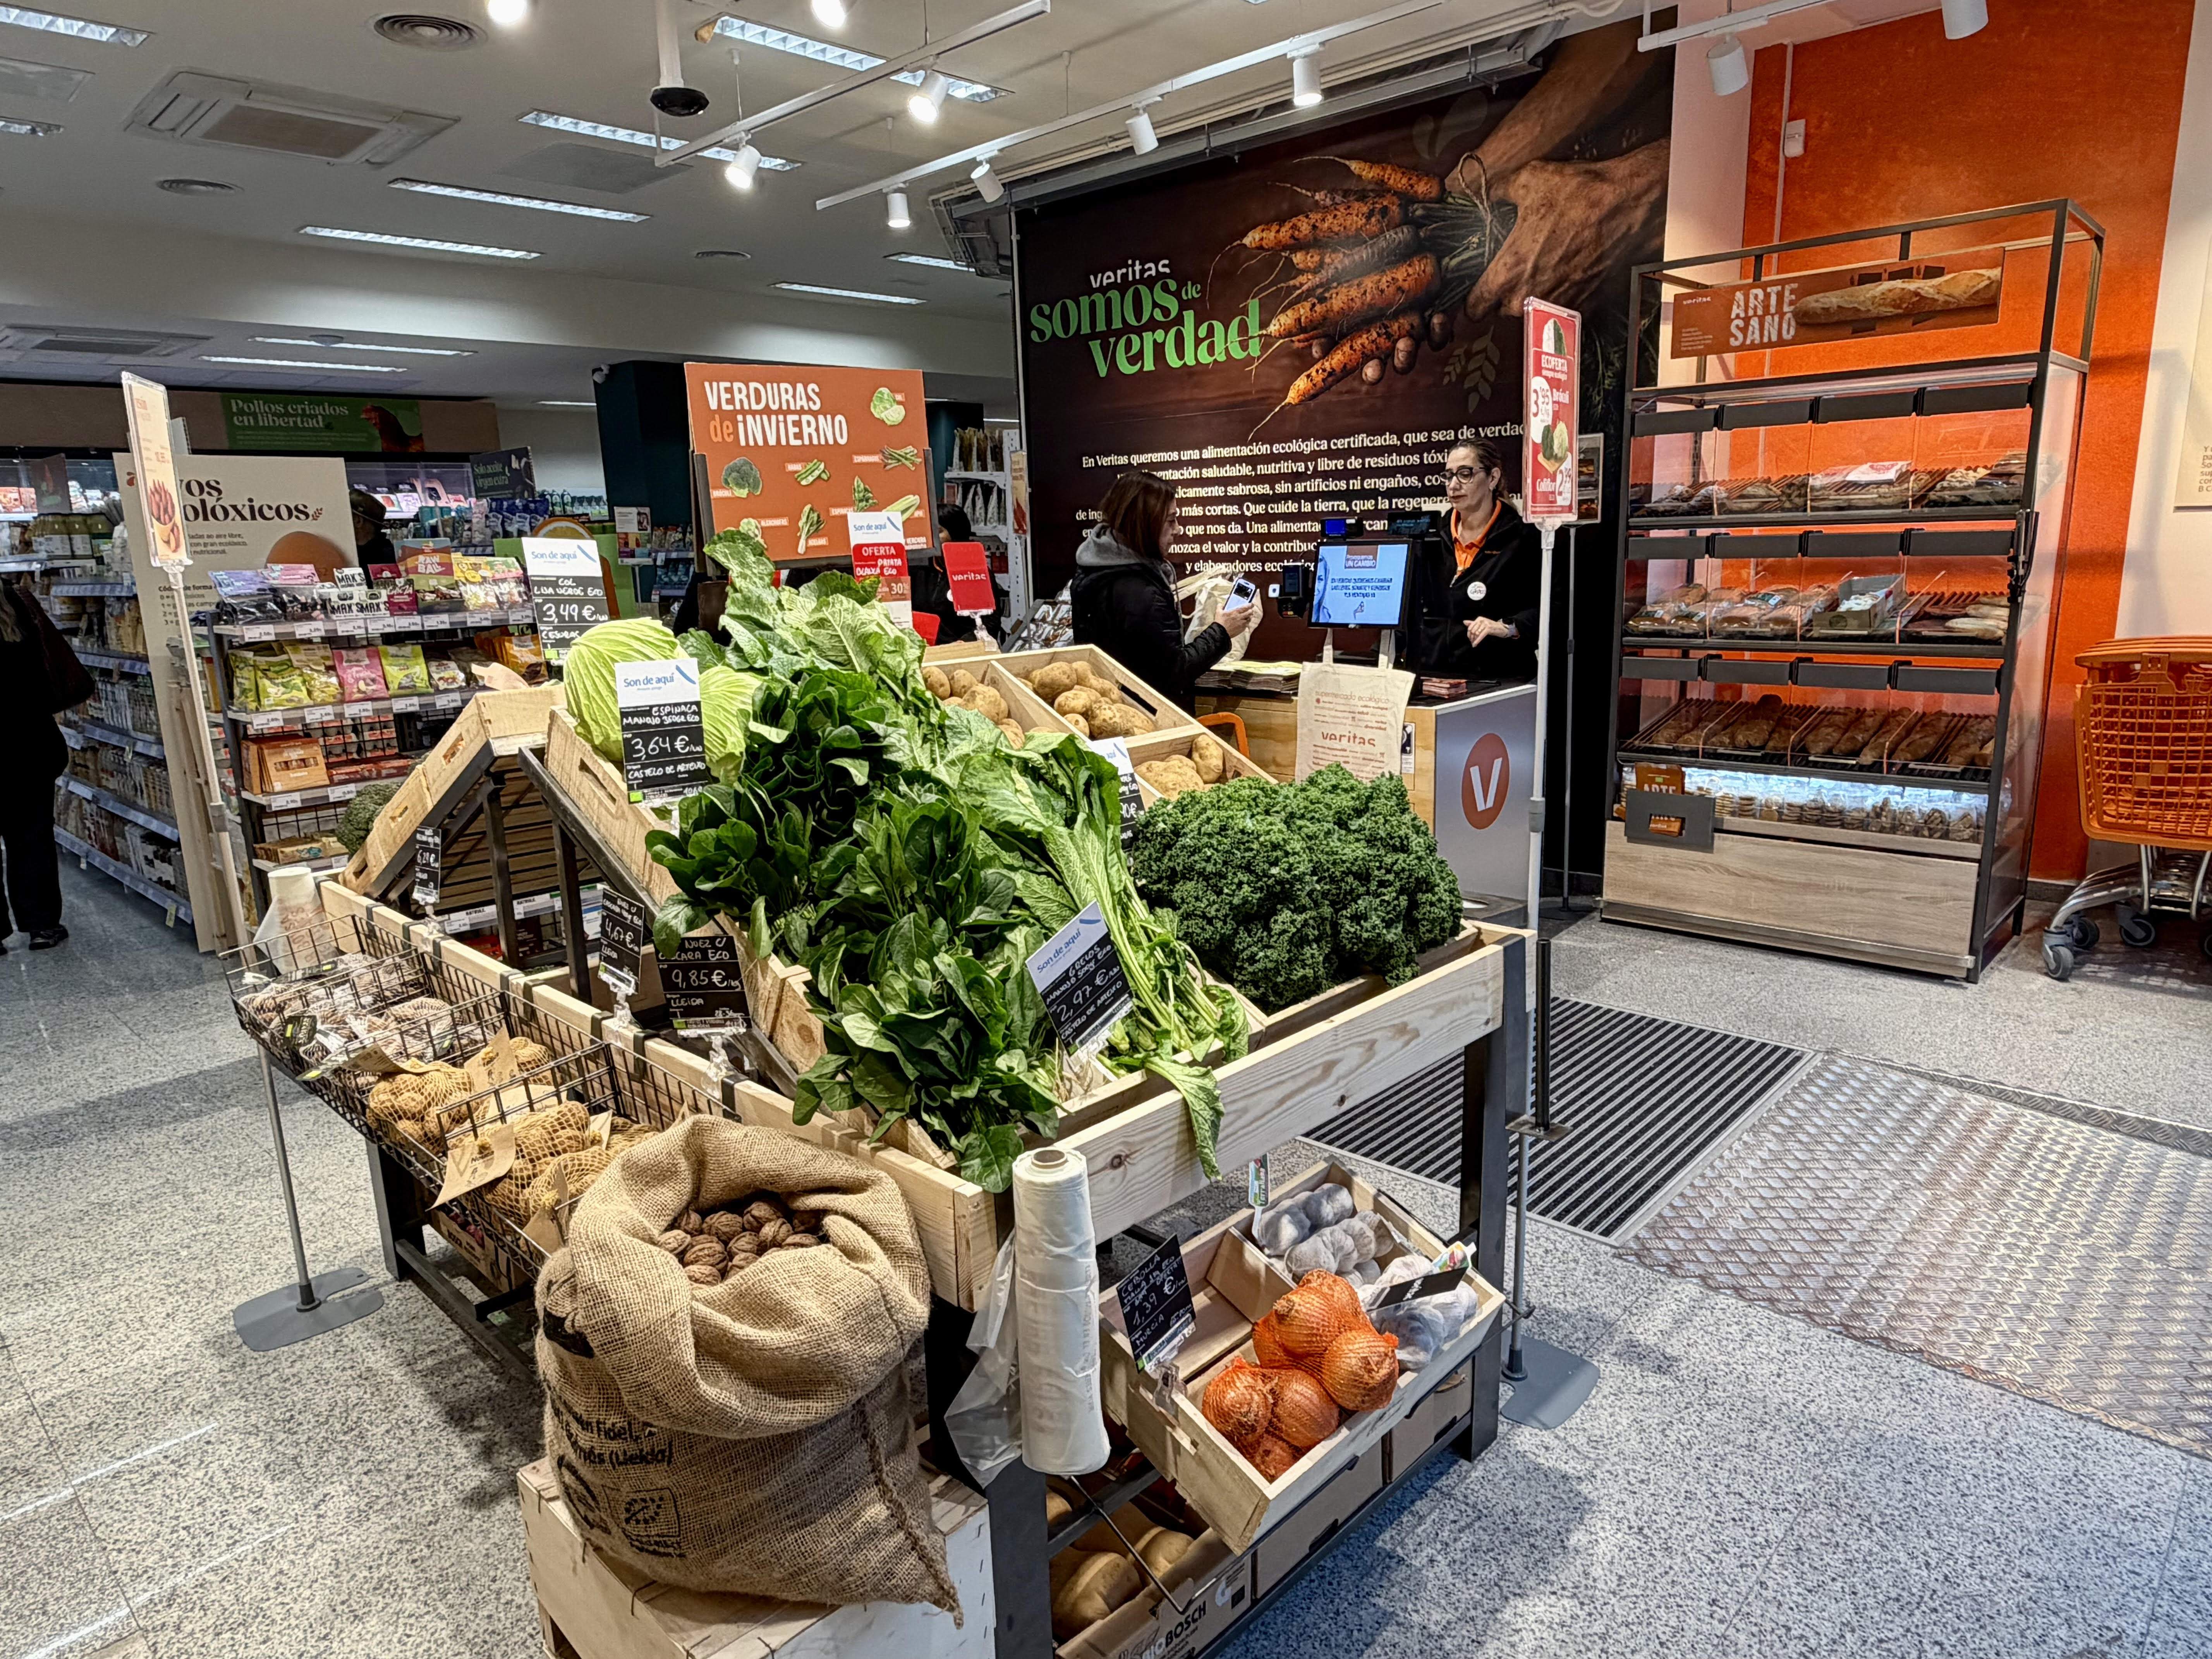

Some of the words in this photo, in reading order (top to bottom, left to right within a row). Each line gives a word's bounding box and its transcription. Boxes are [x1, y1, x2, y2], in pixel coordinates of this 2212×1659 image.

[1090, 259, 1170, 288] veritas
[1730, 282, 1798, 319] ARTE
[1030, 279, 1179, 342] somos
[1182, 282, 1201, 300] de
[1089, 299, 1261, 377] verdad
[1729, 313, 1796, 347] SANO
[1542, 354, 1567, 373] ECOFERTA
[704, 381, 821, 410] VERDURAS
[230, 399, 284, 414] Pollos
[288, 401, 348, 416] criados
[234, 414, 254, 426] en
[258, 413, 323, 428] libertad
[710, 414, 733, 443] de
[1083, 456, 1094, 468] En
[1096, 454, 1128, 466] Veritas
[1130, 452, 1179, 466] queremos
[1181, 450, 1199, 460] una
[1202, 442, 1270, 459] alimentación
[1273, 438, 1327, 455] ecológica
[1331, 433, 1400, 450] certificada,
[1404, 431, 1428, 446] que
[1431, 429, 1455, 441] sea
[1458, 426, 1475, 439] de
[1202, 460, 1255, 479] saludable,
[1257, 459, 1304, 475] nutritiva
[1307, 460, 1315, 474] y
[1318, 457, 1344, 471] libre
[1347, 455, 1362, 469] de
[1365, 452, 1420, 467] residuos
[1227, 482, 1273, 496] sabrosa,
[1275, 481, 1292, 493] sin
[1295, 477, 1346, 493] artificios
[1349, 476, 1360, 489] ni
[1364, 474, 1421, 491] engaños,
[185, 497, 309, 522] olóxicos
[1076, 510, 1087, 520] de
[1088, 508, 1103, 522] ing
[1182, 504, 1203, 516] más
[1206, 504, 1241, 515] cortas.
[1243, 502, 1265, 516] Que
[1268, 501, 1298, 513] cuide
[1301, 500, 1311, 512] la
[1314, 499, 1349, 513] tierra,
[1352, 500, 1375, 513] que
[1378, 496, 1389, 509] la
[874, 522, 887, 532] aquí
[1186, 525, 1204, 537] que
[1207, 524, 1225, 534] nos
[1228, 522, 1243, 534] da.
[1246, 521, 1267, 533] Una
[549, 551, 558, 559] de
[560, 550, 577, 561] aquí
[862, 546, 896, 556] OFERTA
[1202, 541, 1211, 553] el
[1214, 541, 1240, 553] valor
[1243, 543, 1249, 555] y
[1252, 541, 1260, 552] la
[418, 555, 440, 563] RAW
[877, 558, 902, 568] PATATA
[1186, 562, 1193, 574] y
[1195, 560, 1262, 572] elaboradores
[418, 563, 445, 574] BALL
[884, 567, 897, 576] ECO
[952, 571, 987, 581] veritas
[337, 572, 365, 583] MAX'S
[891, 583, 903, 594] 30
[333, 601, 361, 614] MAX'S
[362, 601, 389, 613] MAX'S
[543, 603, 578, 624] 3,49
[624, 678, 641, 687] Son
[642, 675, 653, 685] de
[655, 672, 674, 686] aquí
[623, 716, 660, 726] MANOJO
[687, 713, 699, 722] ECO
[1322, 730, 1376, 747] veritas
[631, 736, 671, 761] 3,64
[665, 765, 675, 774] DE
[1470, 757, 1503, 812] V
[685, 939, 711, 949] NUEZ
[1037, 957, 1053, 973] Son
[1053, 947, 1063, 958] de
[1064, 928, 1082, 949] aquí
[708, 950, 730, 961] ECO
[1069, 944, 1100, 977] GRELOS
[672, 969, 709, 989] 9,85
[1047, 977, 1076, 1005] MANOJO
[1097, 945, 1112, 959] ECO
[1057, 985, 1092, 1022] 2,97
[1087, 1006, 1096, 1015] DE
[1121, 1254, 1161, 1297] CEBOLLA
[1133, 1292, 1158, 1326] 1,39
